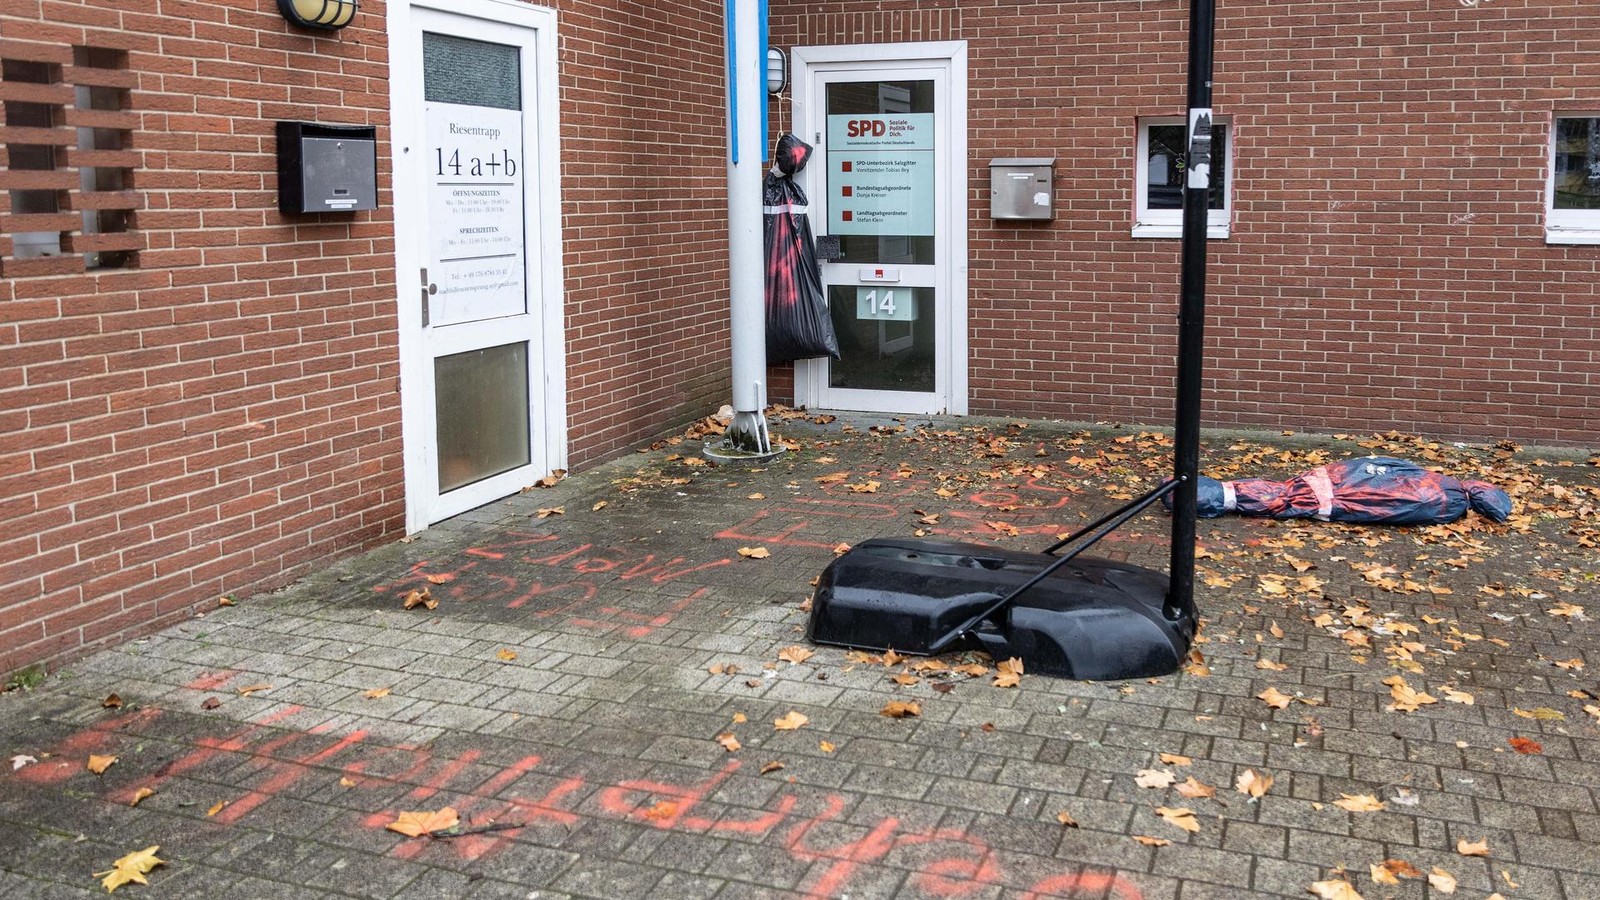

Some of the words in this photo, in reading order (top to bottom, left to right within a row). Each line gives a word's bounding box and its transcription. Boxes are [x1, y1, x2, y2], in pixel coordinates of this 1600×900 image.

[449, 122, 501, 140] Riesentrapp
[847, 119, 886, 137] SPD
[435, 147, 462, 176] 14
[470, 149, 517, 177] a+b
[452, 188, 501, 197] ÖFFNUNGSZEITEN
[460, 226, 499, 234] SPRECHZEITEN
[866, 290, 896, 315] 14
